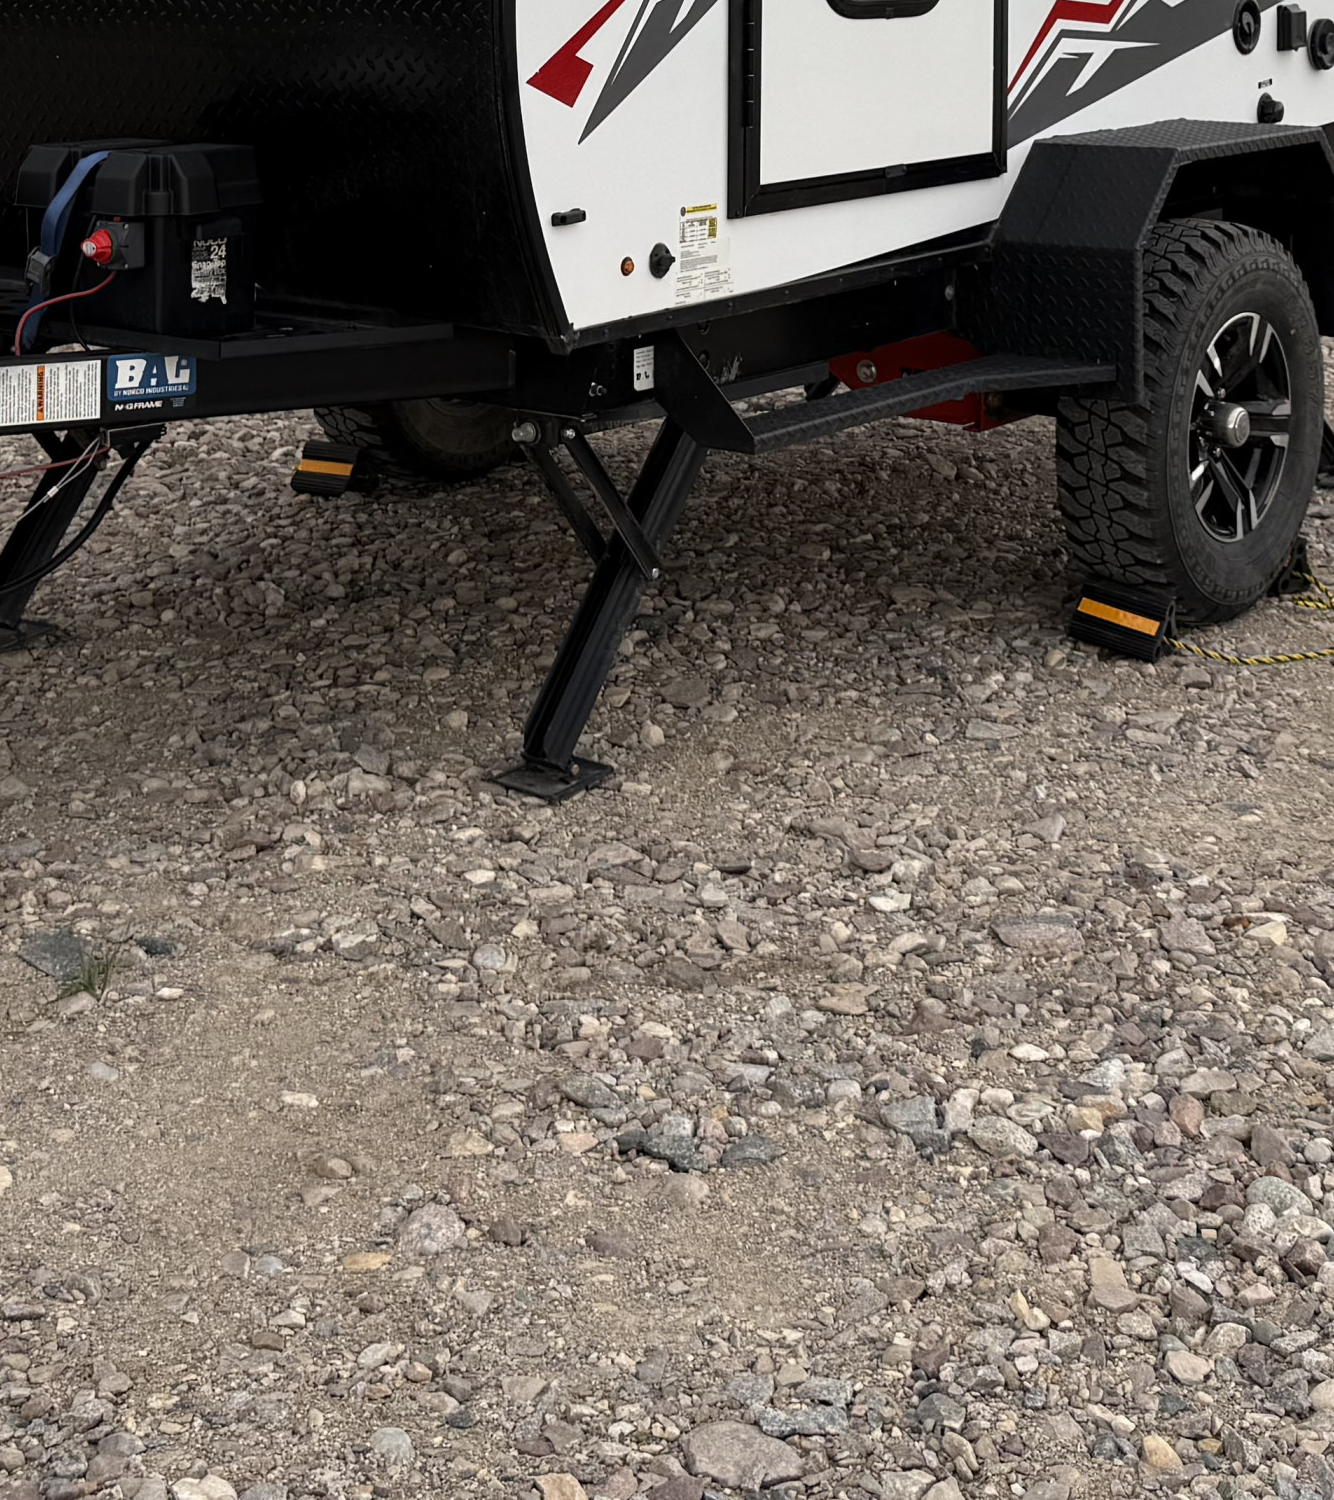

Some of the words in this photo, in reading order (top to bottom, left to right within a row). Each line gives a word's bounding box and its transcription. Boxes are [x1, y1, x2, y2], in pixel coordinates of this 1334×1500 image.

[210, 244, 227, 259] 24
[114, 355, 191, 389] BAL
[37, 371, 45, 408] WARNING
[122, 387, 145, 396] NORCO
[145, 384, 183, 394] INDUSTRIES
